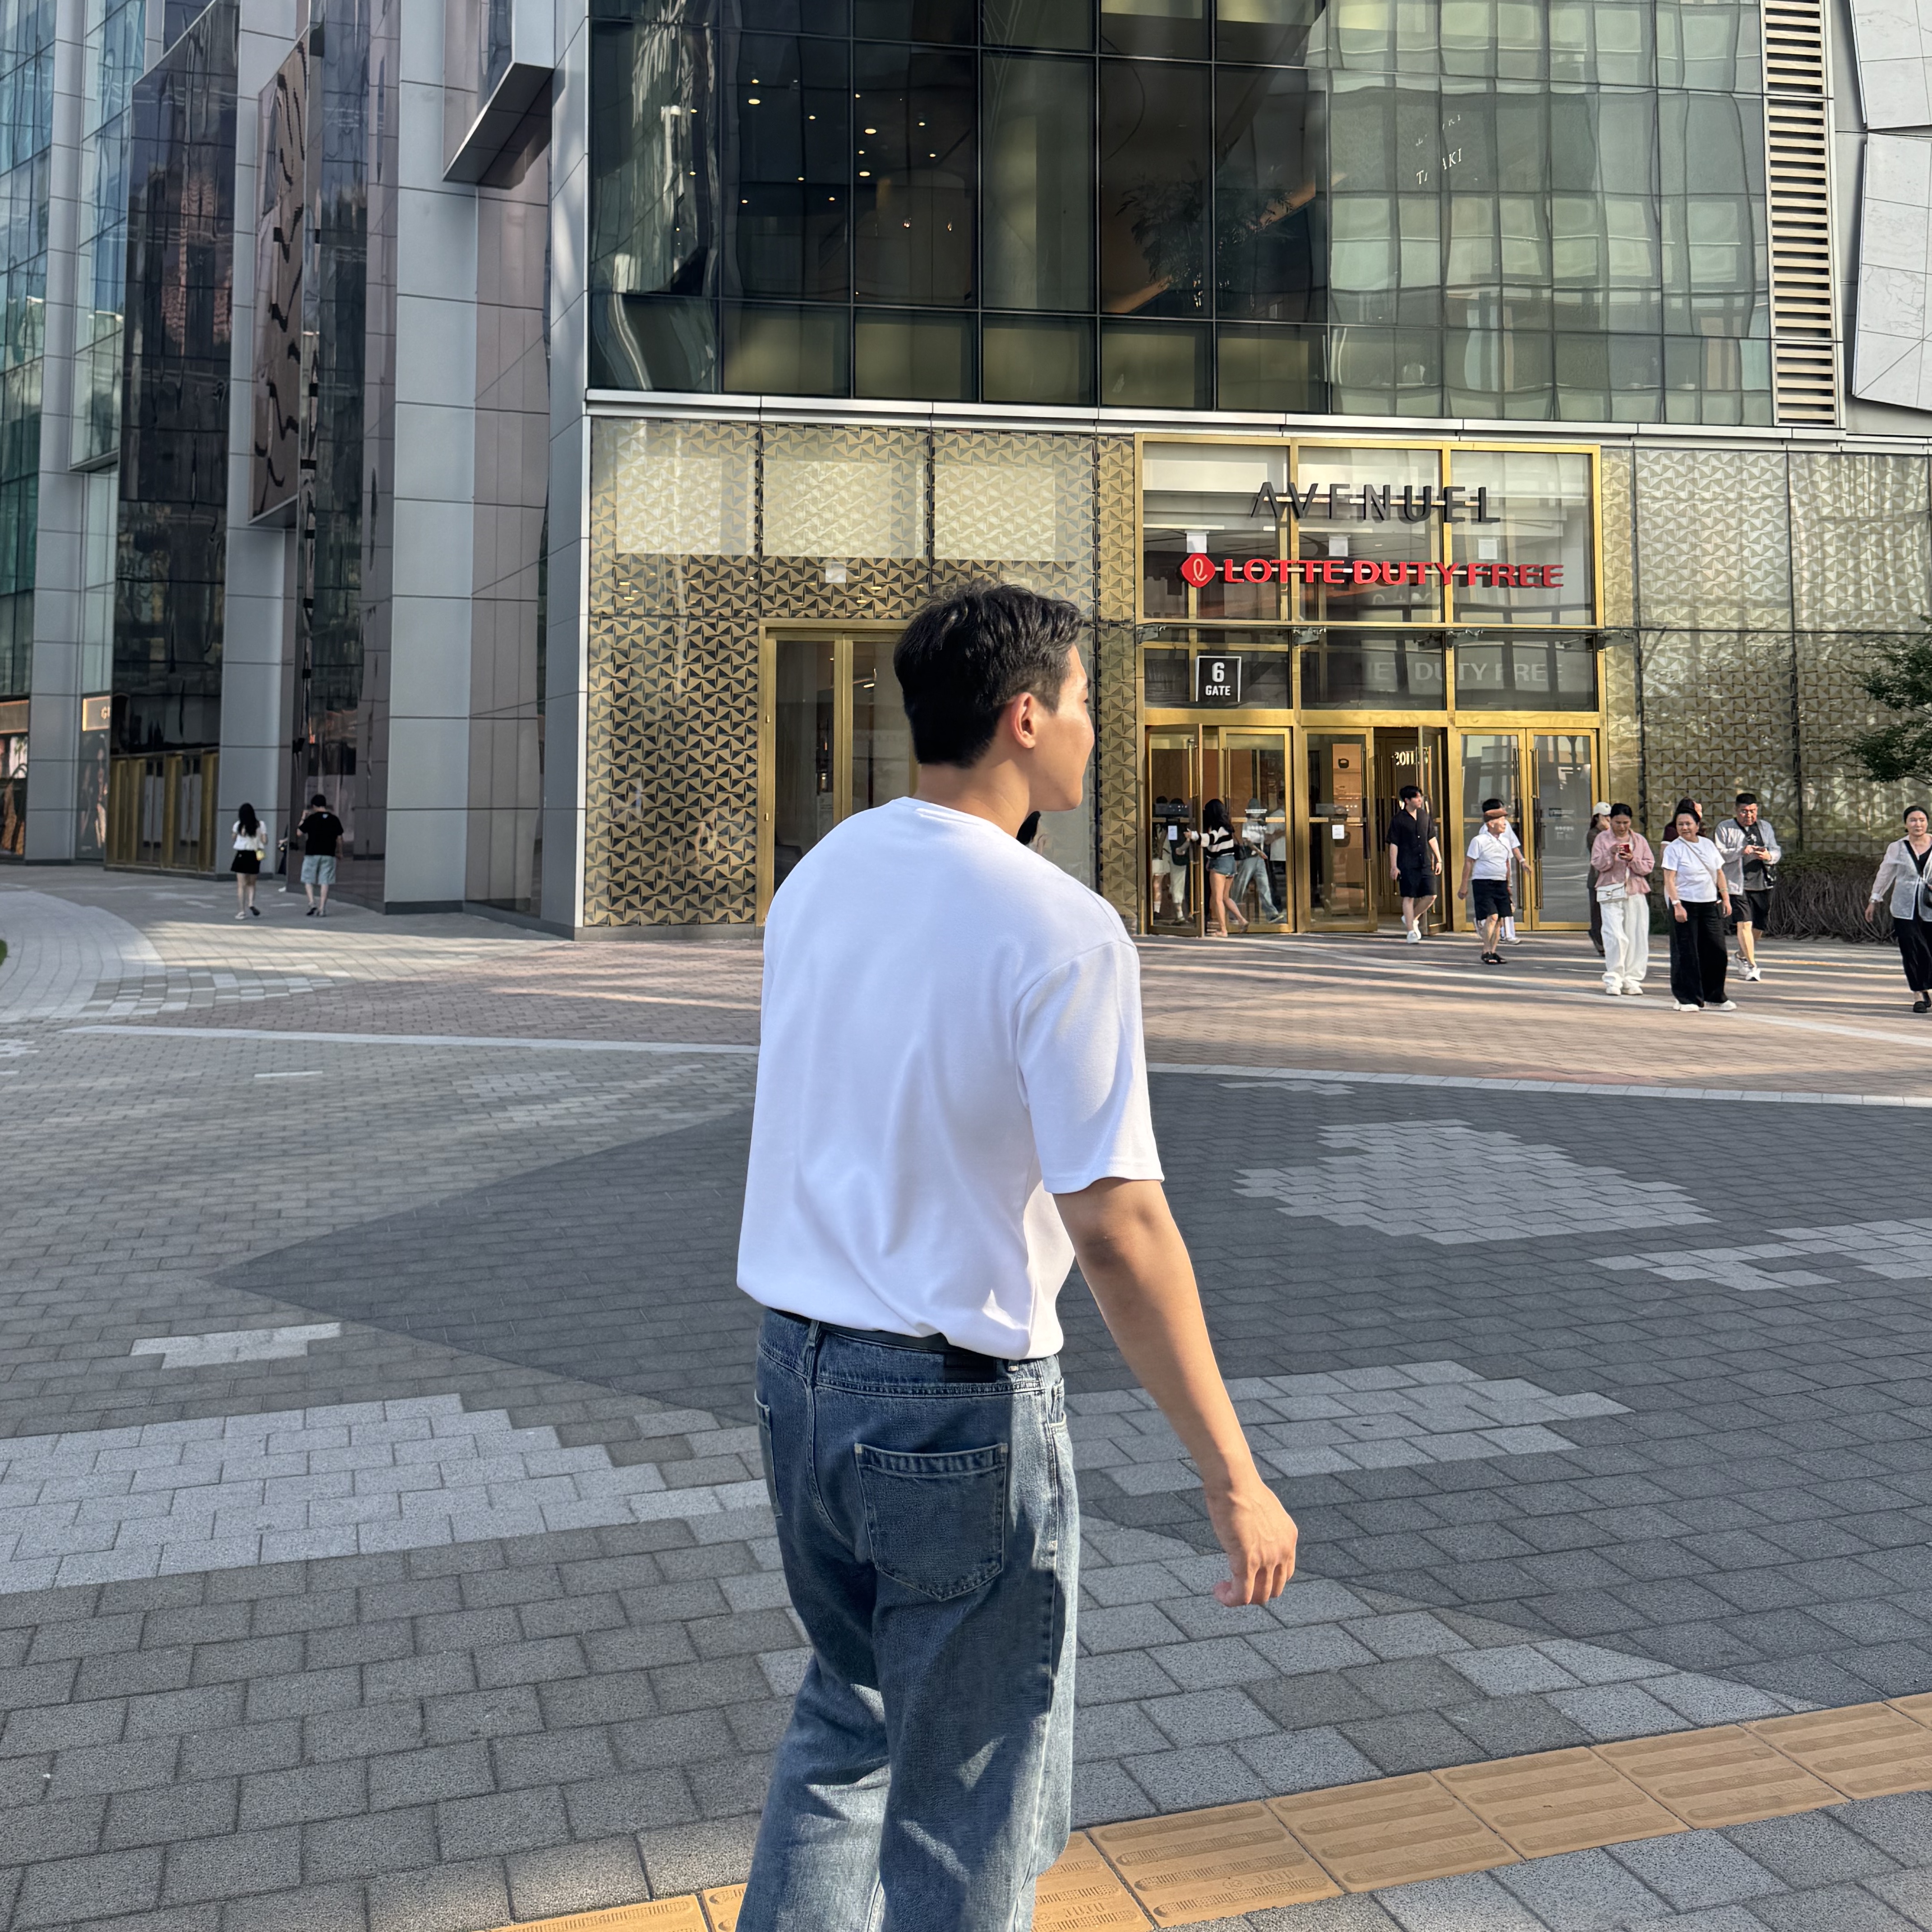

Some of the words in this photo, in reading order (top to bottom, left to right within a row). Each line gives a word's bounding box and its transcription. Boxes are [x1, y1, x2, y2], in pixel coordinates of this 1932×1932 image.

[1250, 482, 1501, 523] AVENUEL
[1224, 558, 1345, 584] LOTTE
[1353, 560, 1459, 586] DUTY
[1467, 562, 1564, 587] FREE
[1212, 662, 1225, 682] 6
[1205, 685, 1231, 696] GATE
